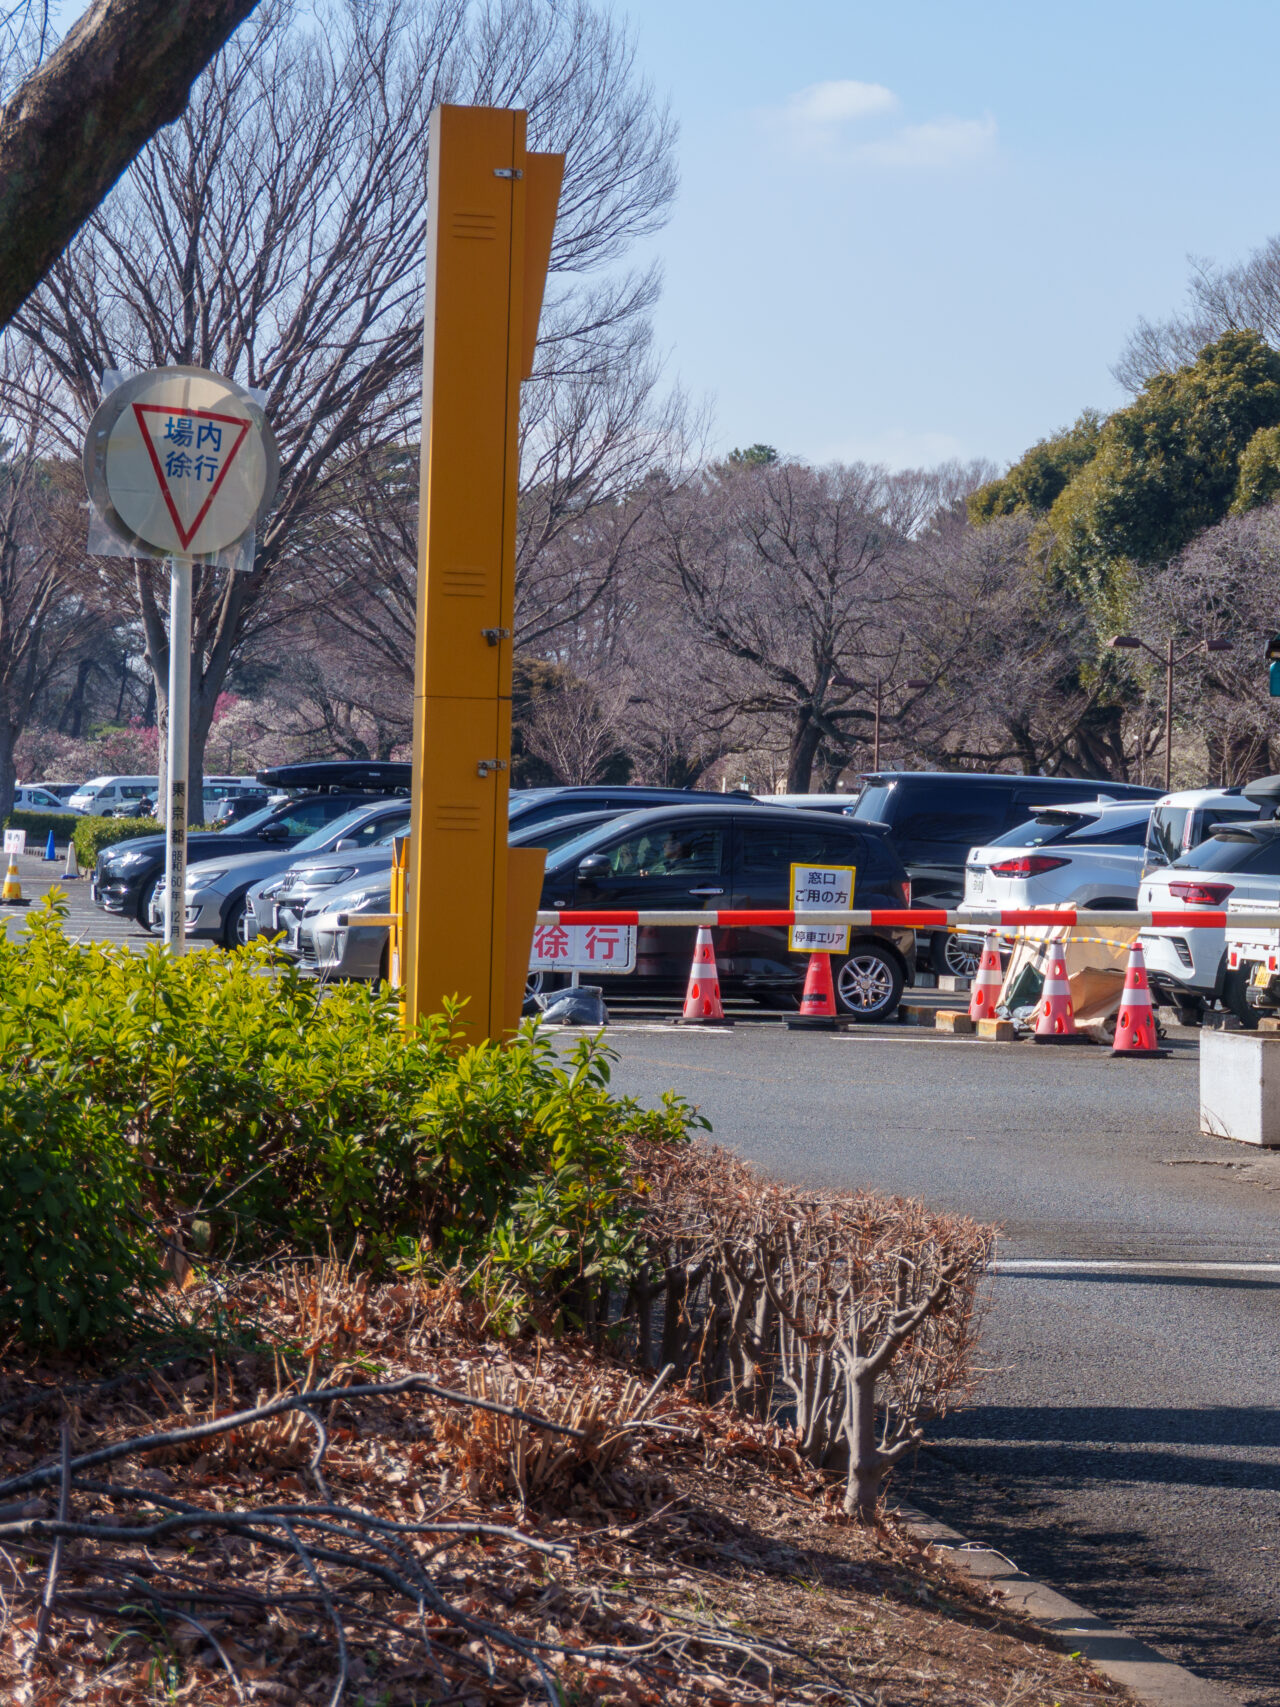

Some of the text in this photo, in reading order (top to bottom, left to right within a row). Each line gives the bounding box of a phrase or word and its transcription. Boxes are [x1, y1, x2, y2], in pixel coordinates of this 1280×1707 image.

[163, 416, 222, 452] 場内
[165, 451, 219, 482] 徐行
[172, 782, 185, 843] 東京都
[808, 872, 837, 885] 窓口
[795, 889, 848, 904] ご用の方
[534, 925, 619, 960] 徐行
[795, 930, 844, 944] 停車エリア
